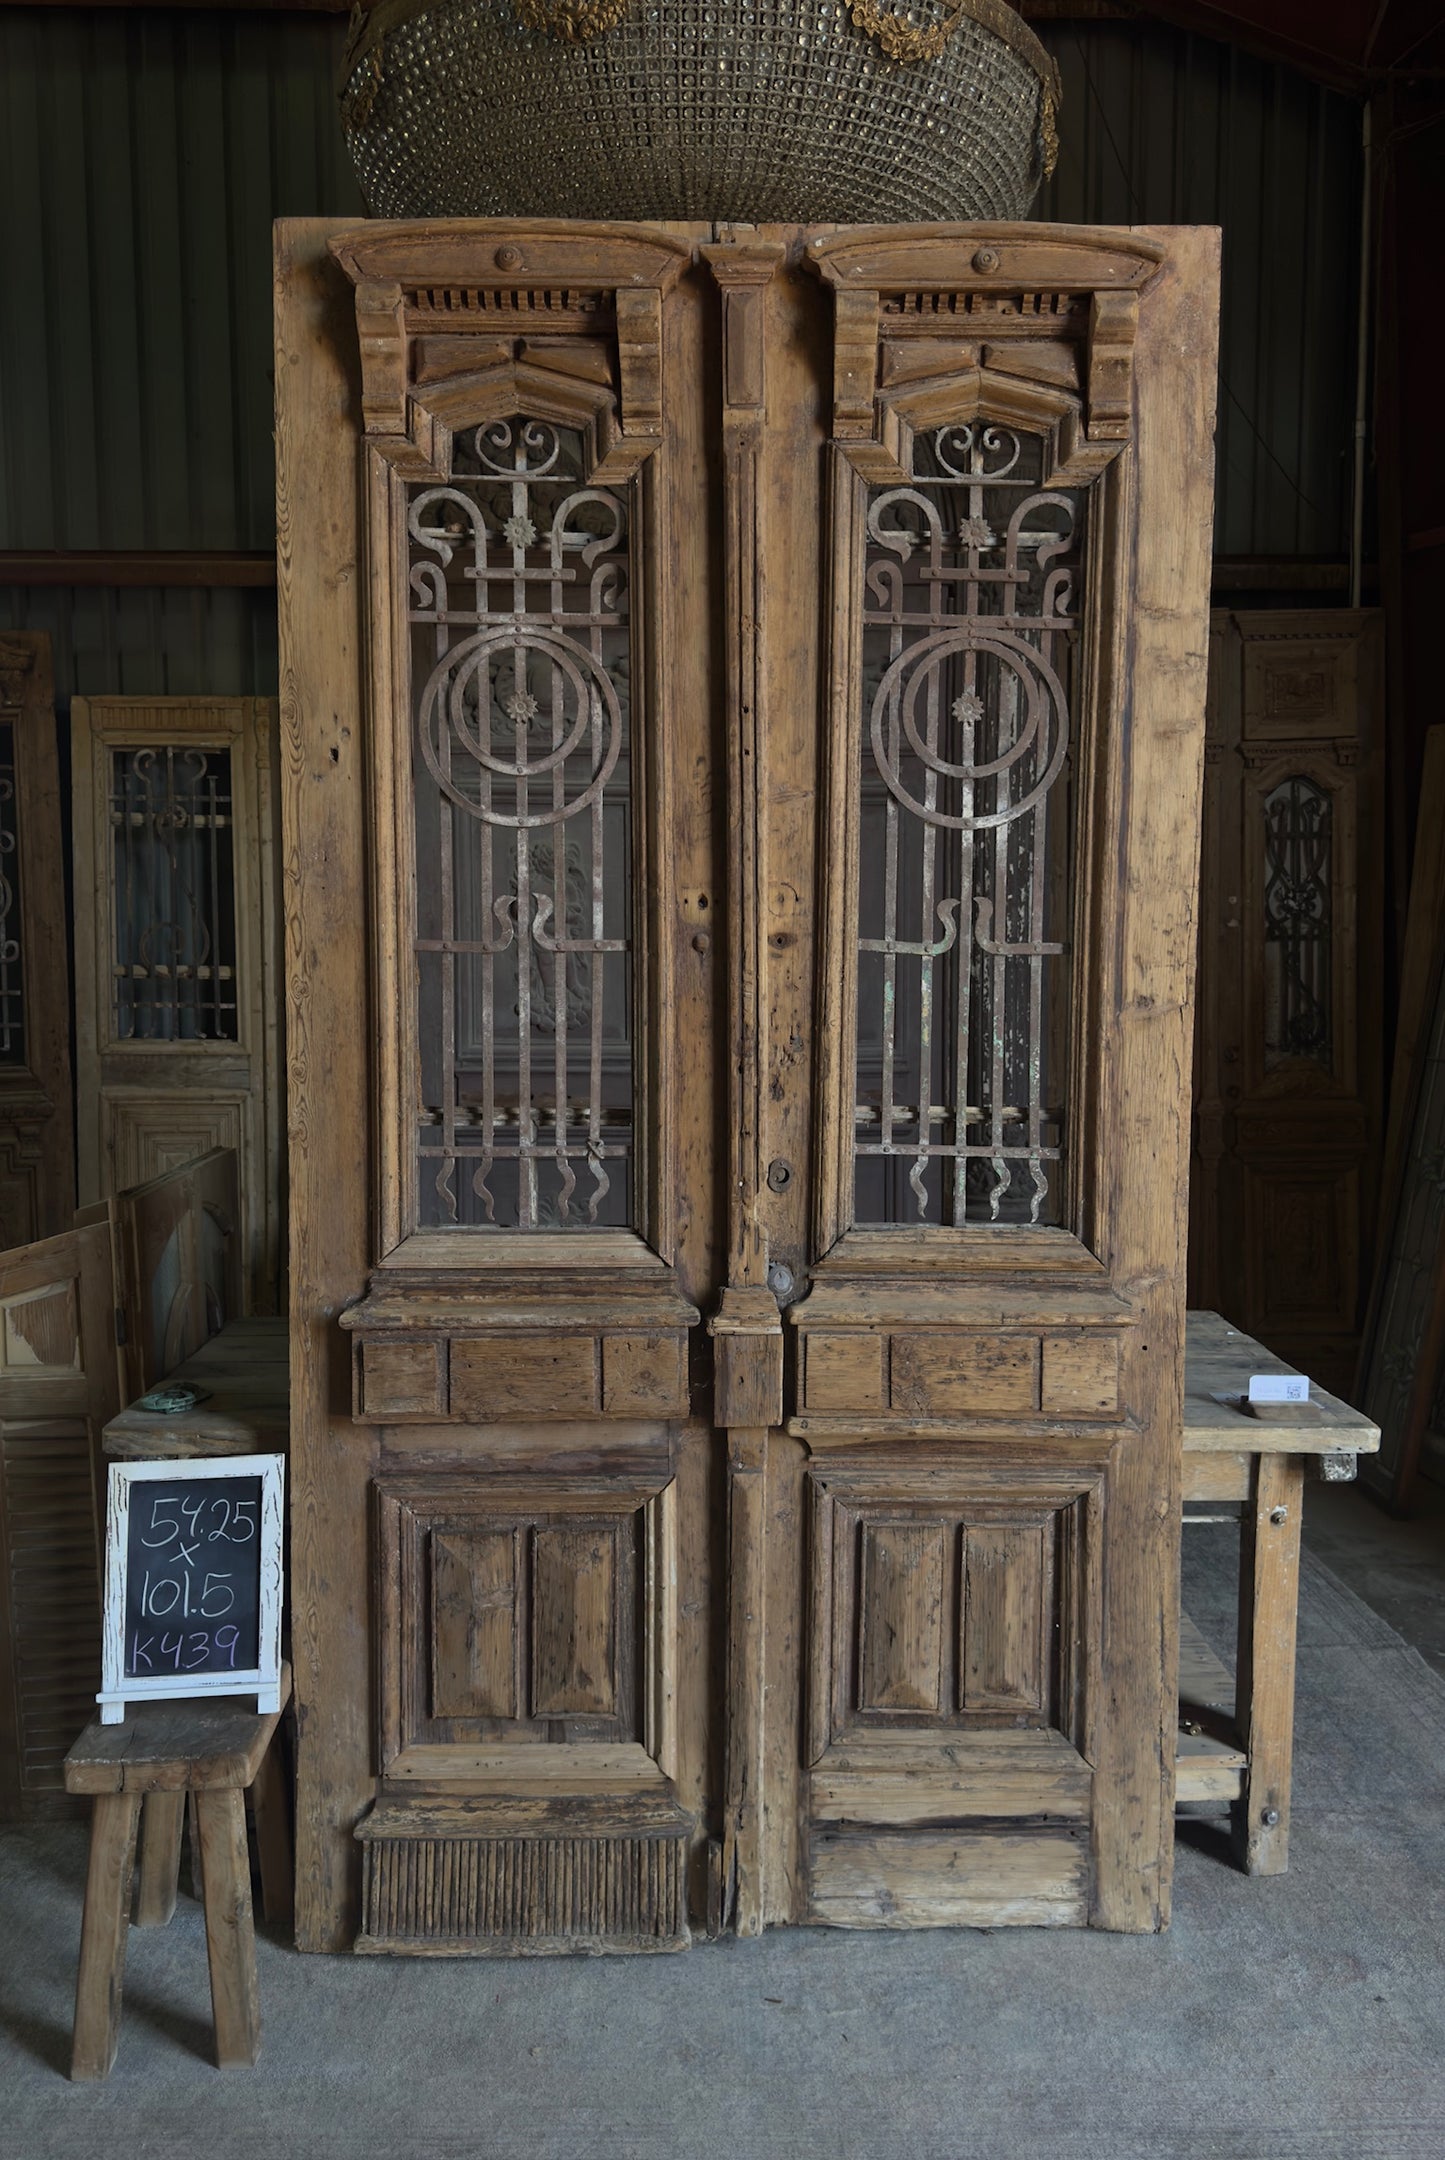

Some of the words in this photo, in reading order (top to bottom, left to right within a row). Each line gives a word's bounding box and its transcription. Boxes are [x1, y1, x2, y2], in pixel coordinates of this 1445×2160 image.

[141, 1496, 257, 1548] 54.25
[141, 1570, 235, 1618] 101.5
[131, 1624, 240, 1674] K439
